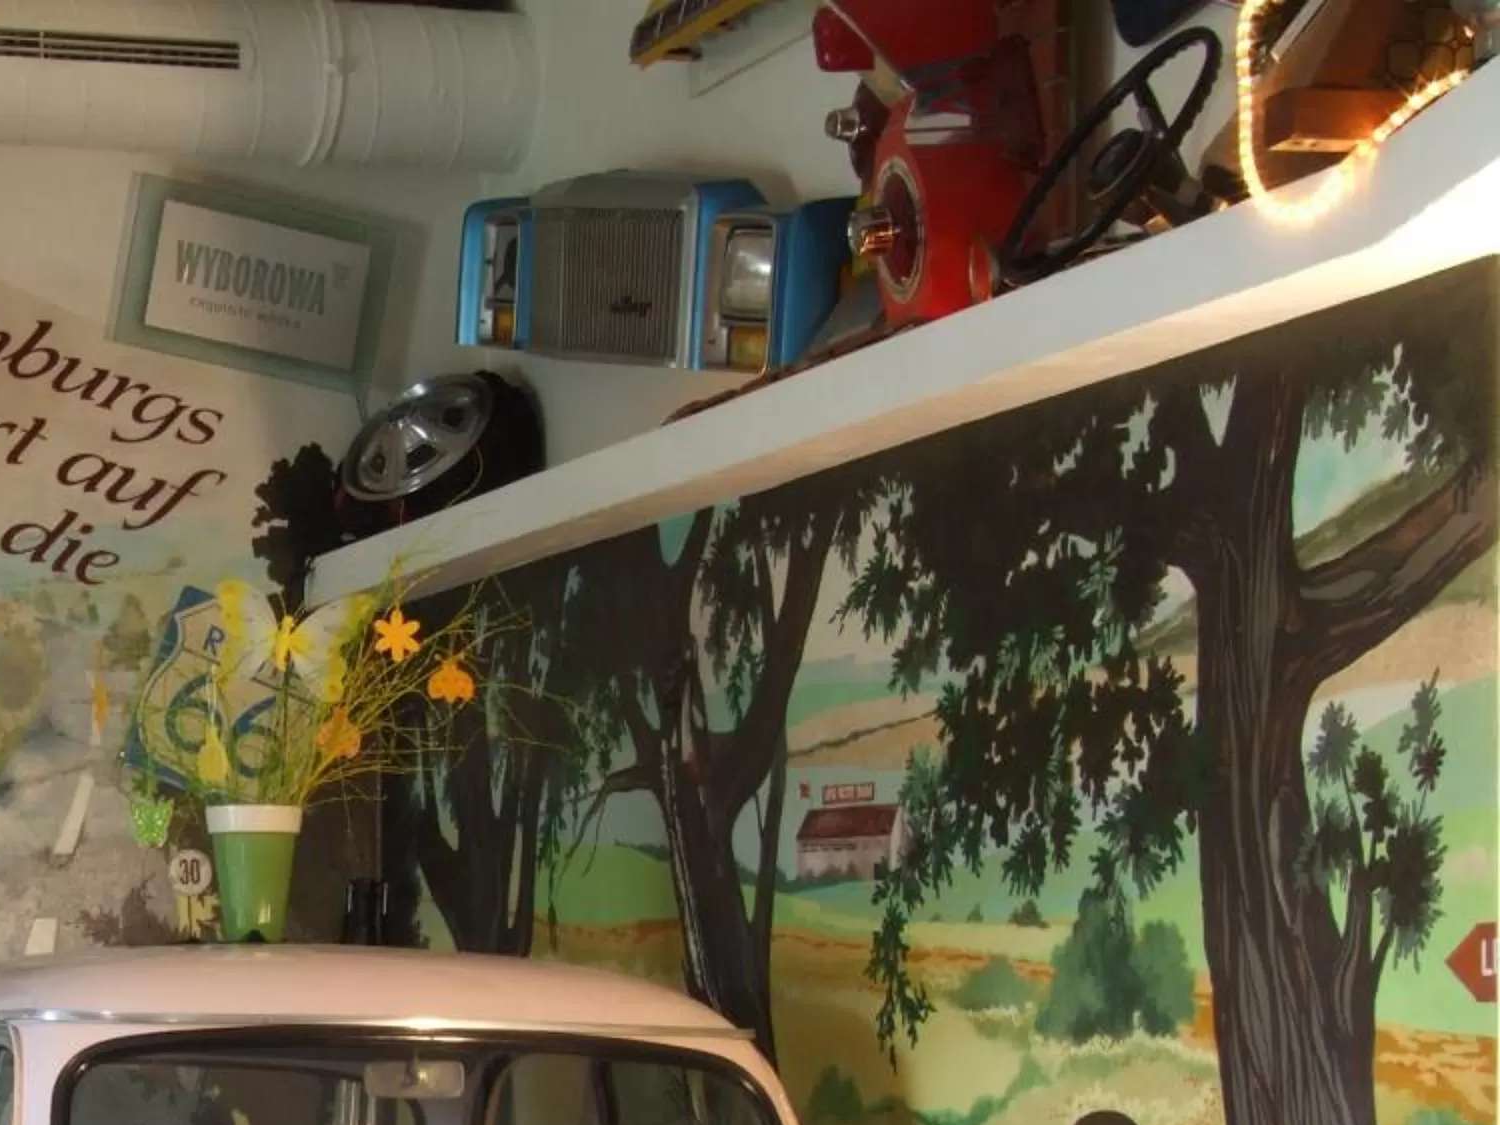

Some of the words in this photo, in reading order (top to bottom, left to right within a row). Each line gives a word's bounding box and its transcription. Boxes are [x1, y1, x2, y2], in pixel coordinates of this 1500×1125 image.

[176, 239, 325, 316] WYBOROWA
[55, 451, 228, 531] auf
[0, 508, 121, 585] die
[179, 857, 201, 885] 30
